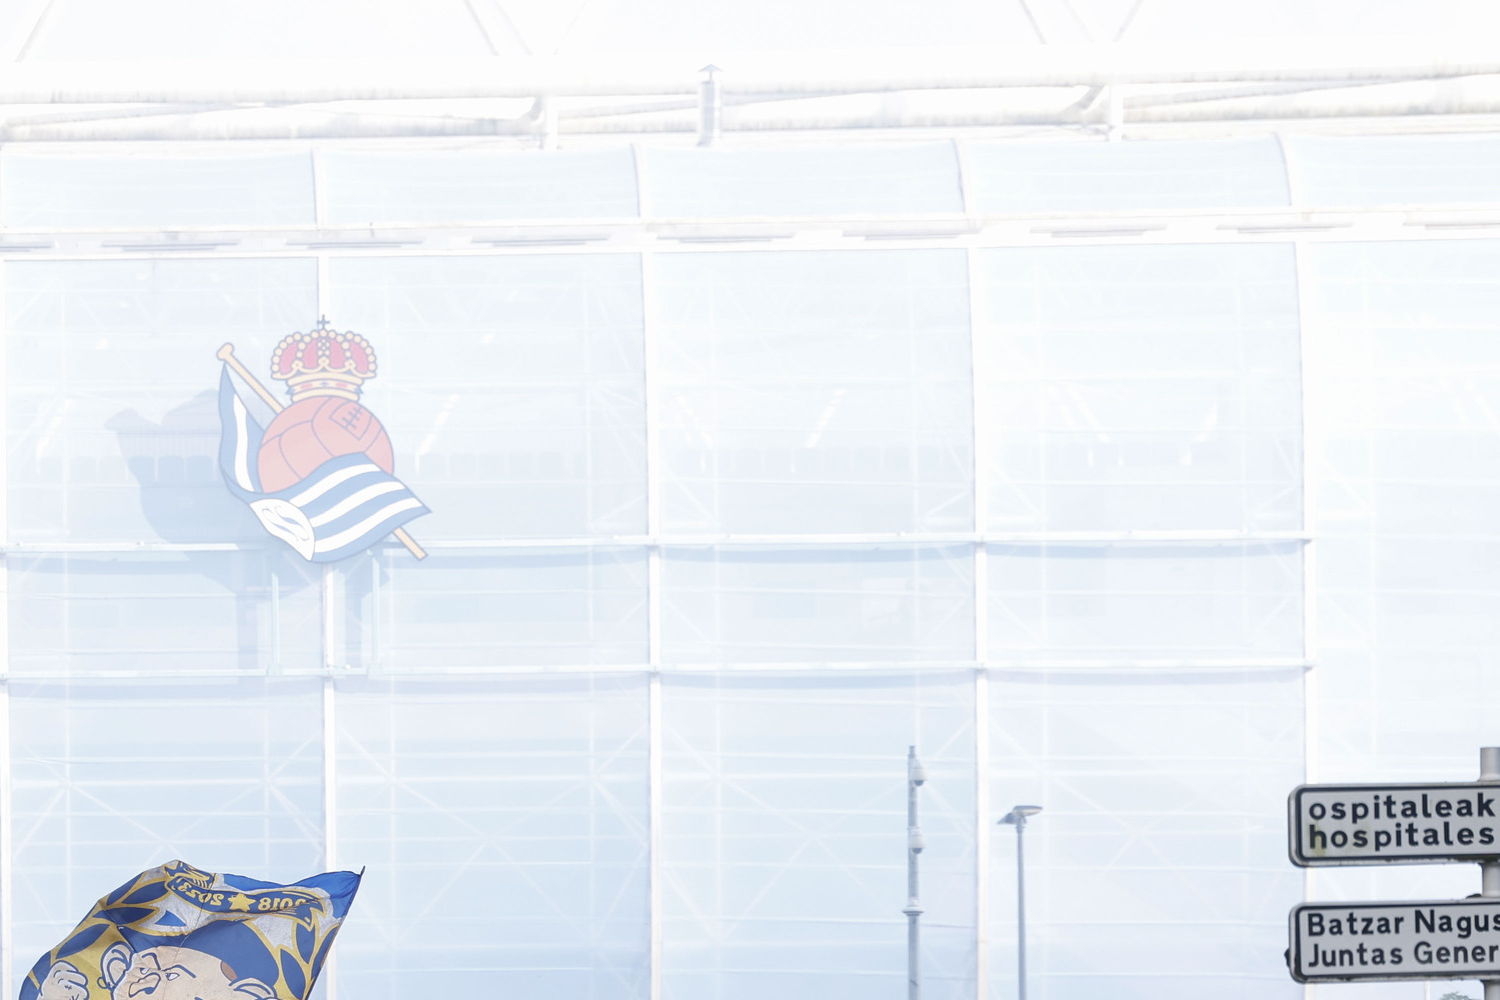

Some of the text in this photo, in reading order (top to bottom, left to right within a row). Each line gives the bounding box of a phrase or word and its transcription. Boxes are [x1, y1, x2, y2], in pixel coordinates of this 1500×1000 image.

[1308, 792, 1496, 824] ospitaleak
[1308, 821, 1496, 852] hospitales
[1308, 912, 1405, 937] Batzar
[1308, 940, 1499, 968] Juntas Gener
